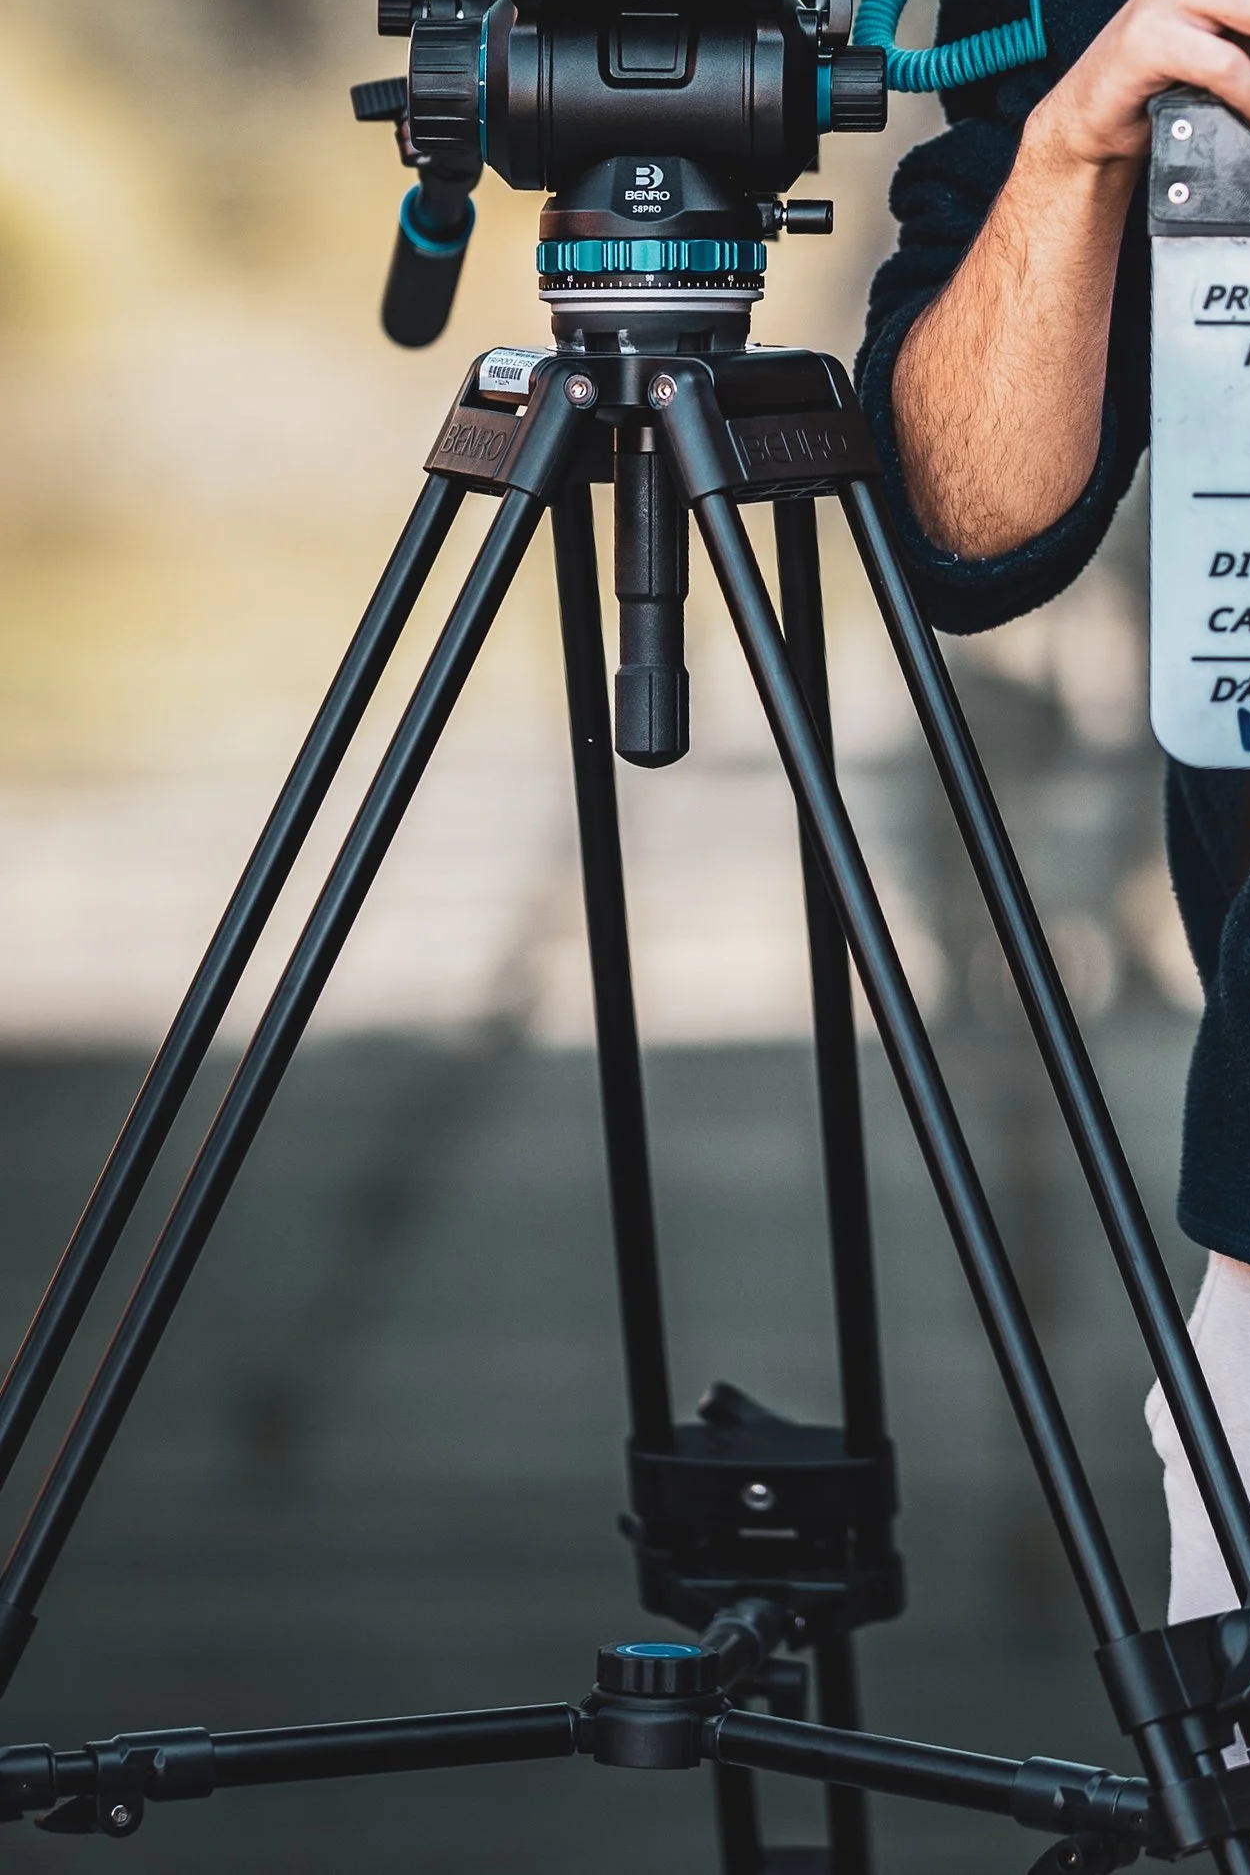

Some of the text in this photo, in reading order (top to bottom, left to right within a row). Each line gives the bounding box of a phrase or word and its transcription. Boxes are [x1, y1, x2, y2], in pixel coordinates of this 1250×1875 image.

[624, 190, 671, 201] BENRO
[632, 205, 662, 214] S8PRO
[645, 275, 655, 283] 90
[487, 356, 535, 368] TRIPOD LEGS
[440, 423, 507, 462] BENRO
[739, 429, 847, 466] BENRO
